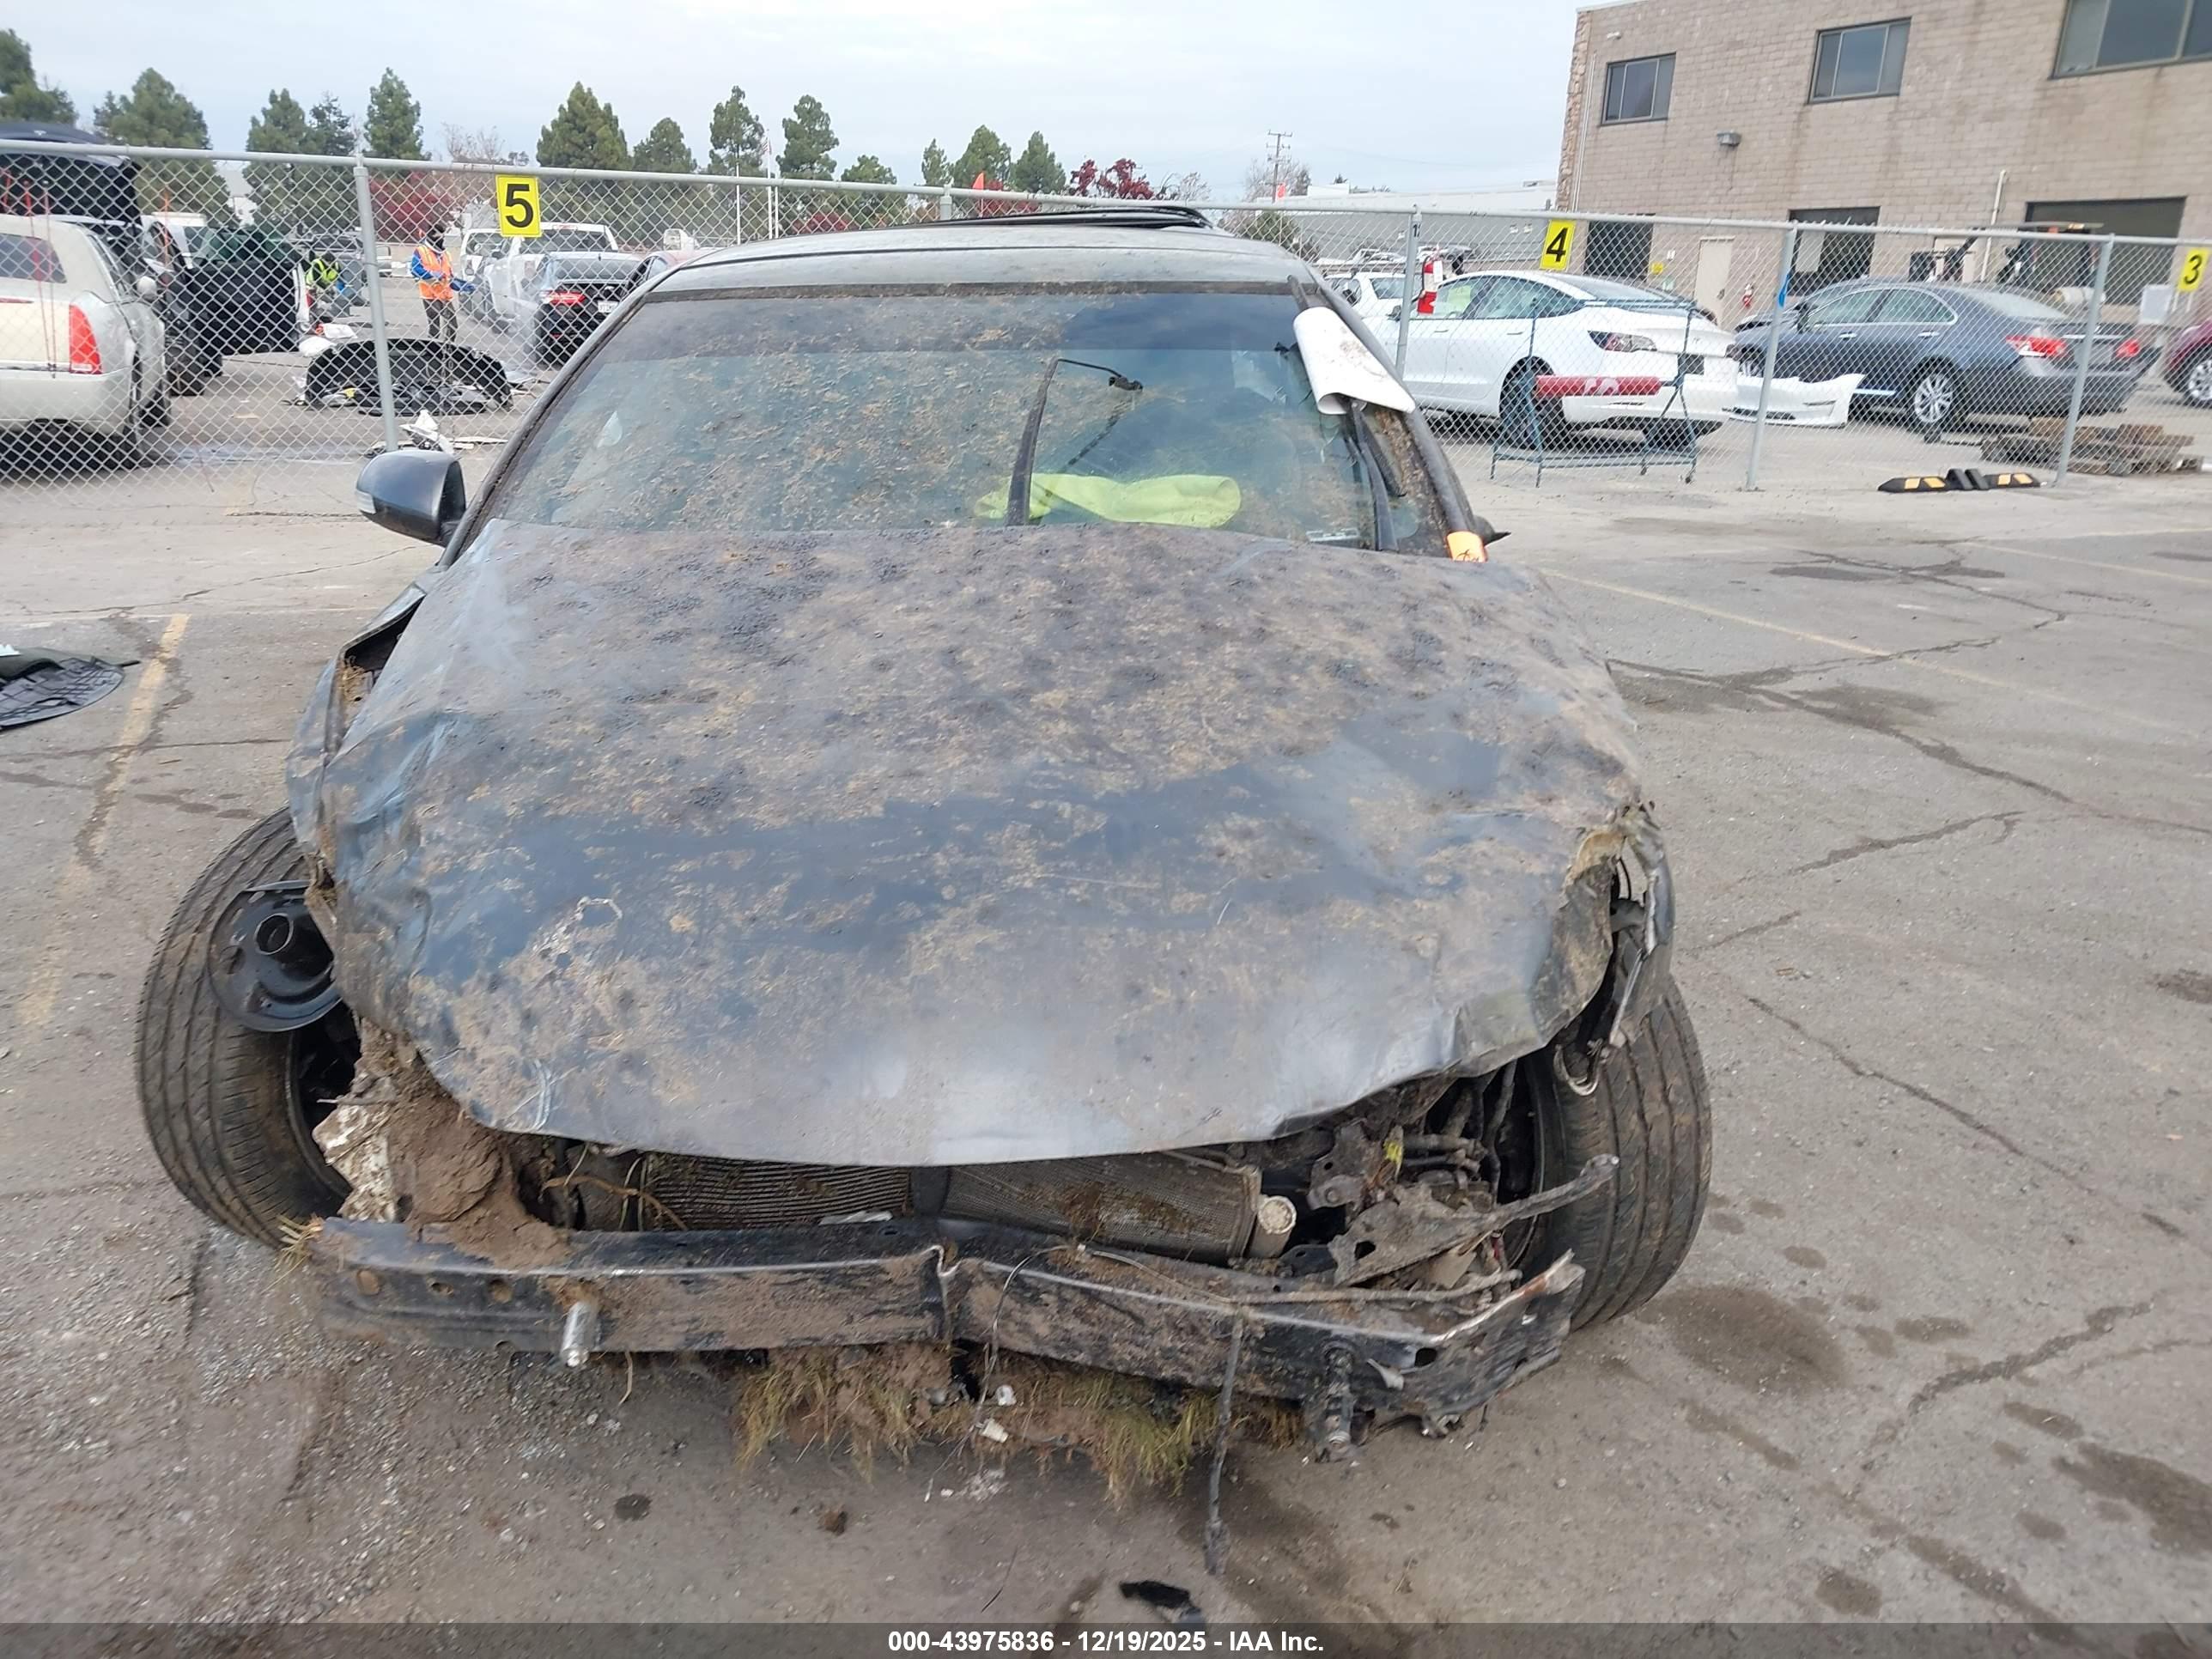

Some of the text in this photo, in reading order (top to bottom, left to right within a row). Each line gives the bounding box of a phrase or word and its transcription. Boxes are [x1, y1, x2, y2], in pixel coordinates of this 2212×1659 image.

[505, 183, 534, 228] 5
[1545, 227, 1569, 263] 4
[2183, 253, 2203, 285] 3
